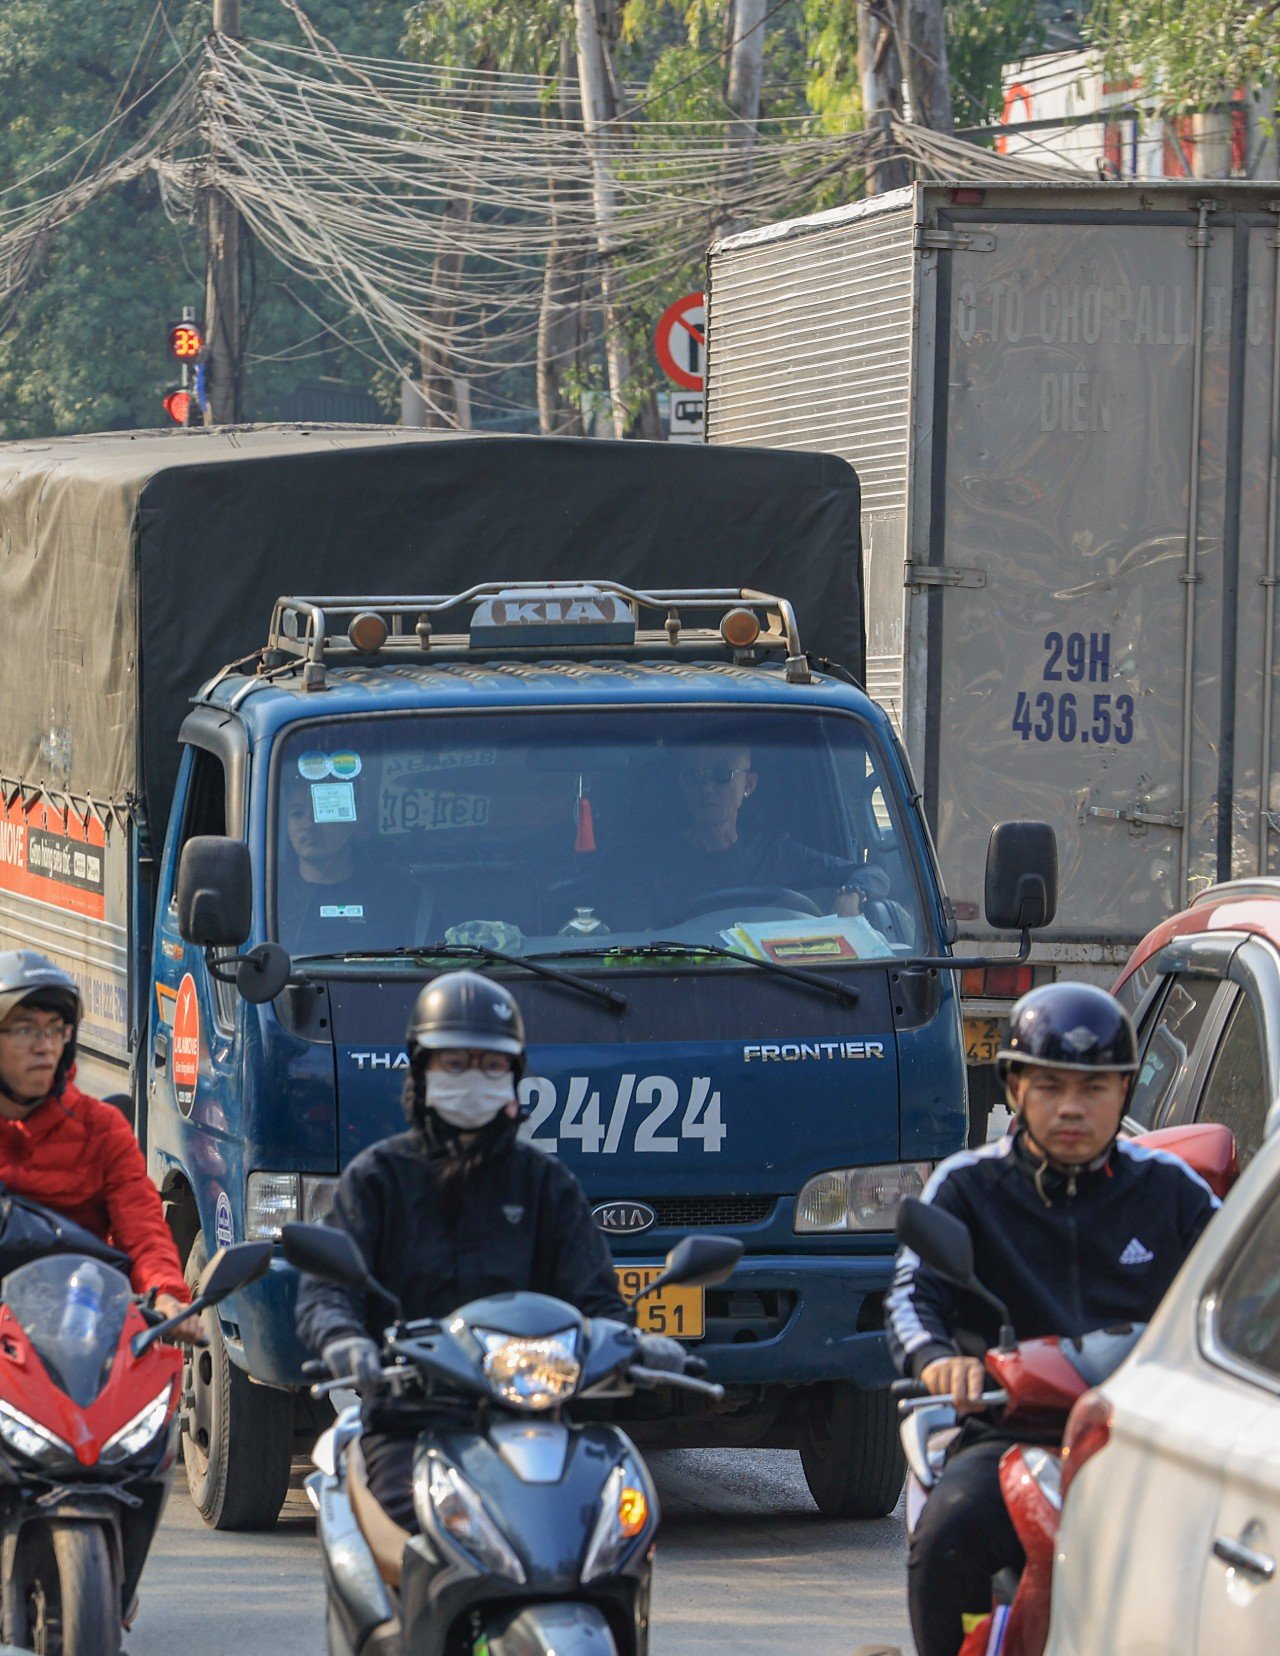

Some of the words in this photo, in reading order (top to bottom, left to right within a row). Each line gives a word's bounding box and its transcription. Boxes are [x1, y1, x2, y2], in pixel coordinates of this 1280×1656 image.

[1114, 284, 1227, 346] PALLT
[504, 600, 607, 624] KIA
[1043, 632, 1111, 682] 29H
[1012, 692, 1134, 744] 436.53
[743, 1041, 885, 1063] FRONTIER
[519, 1073, 727, 1154] 24/24
[601, 1209, 646, 1227] KIA
[613, 1271, 662, 1300] 9H
